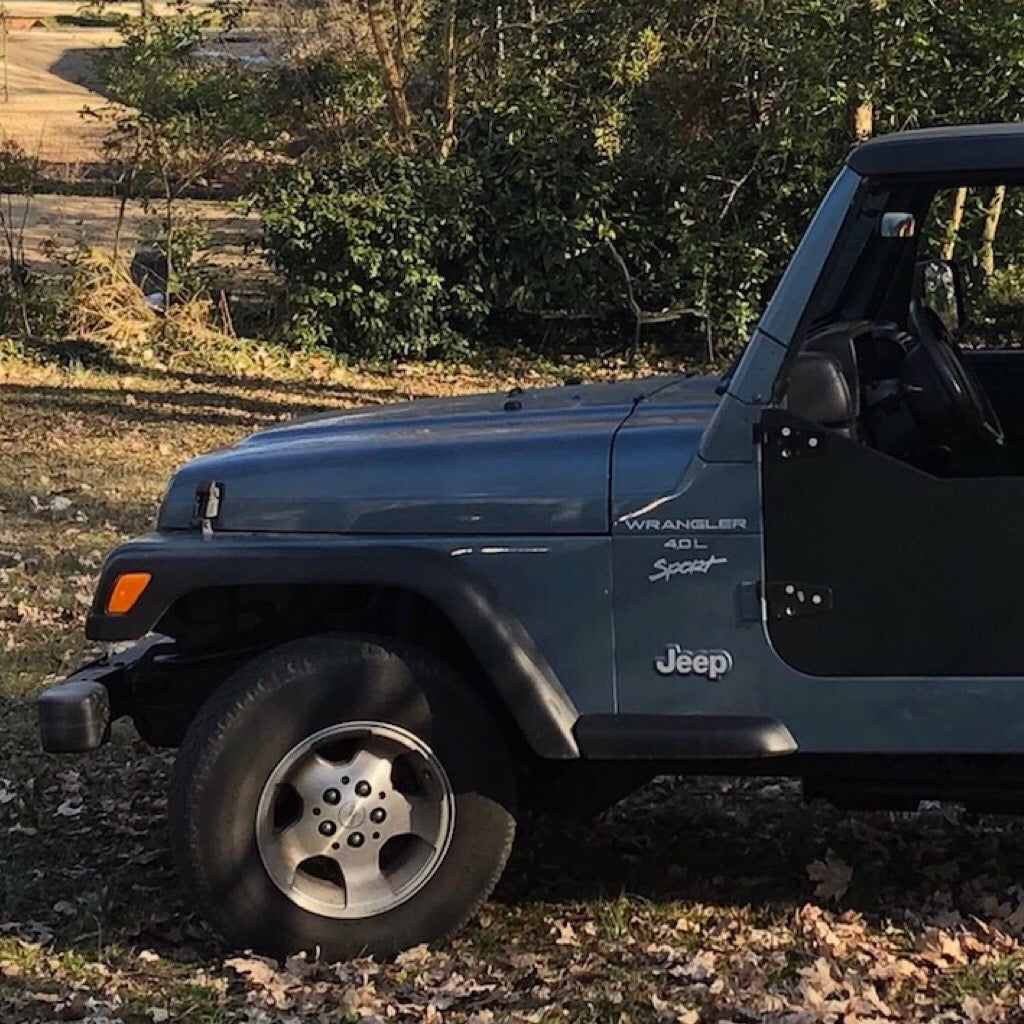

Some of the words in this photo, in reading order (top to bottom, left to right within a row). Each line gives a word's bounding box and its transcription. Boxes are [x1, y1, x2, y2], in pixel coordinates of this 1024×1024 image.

[626, 519, 747, 530] WRANGLER
[649, 555, 727, 581] Sport
[657, 648, 727, 678] Jeep
